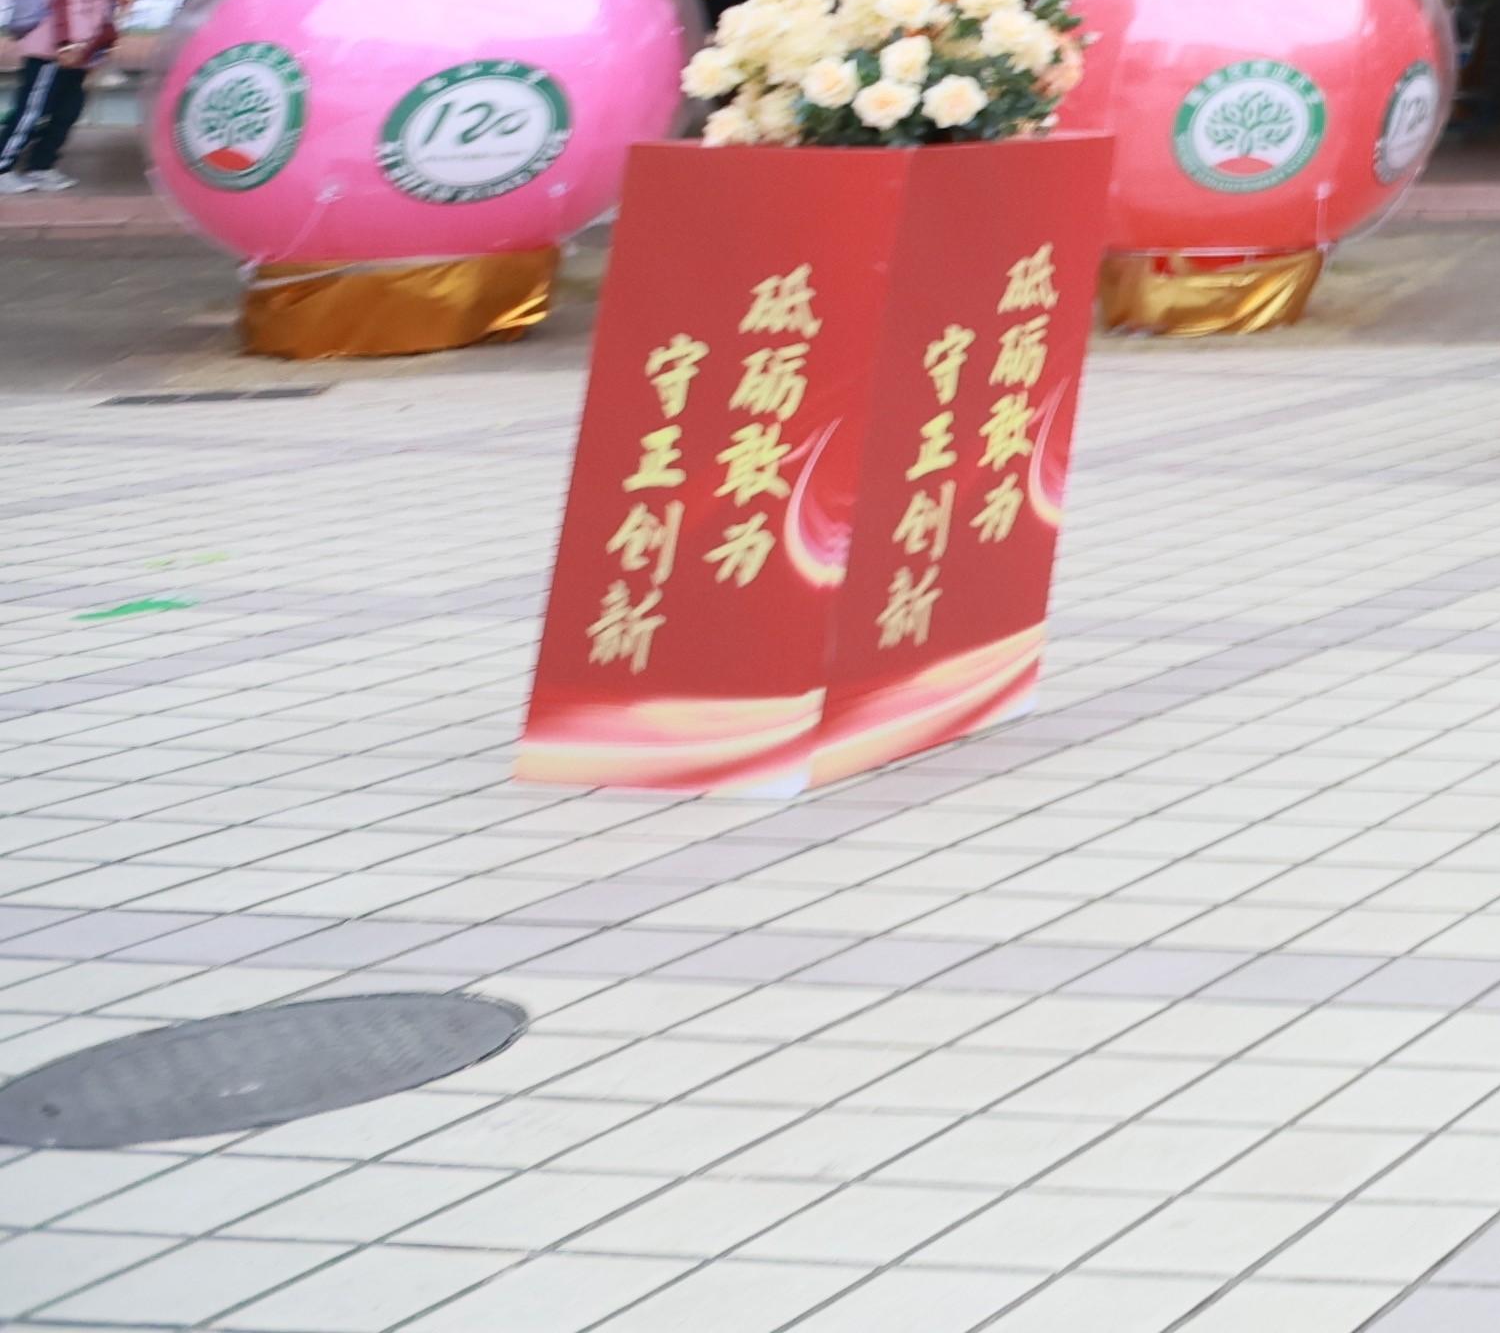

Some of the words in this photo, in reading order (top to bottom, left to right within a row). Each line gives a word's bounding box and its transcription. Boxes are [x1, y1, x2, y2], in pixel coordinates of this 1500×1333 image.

[586, 333, 710, 675] 守正创新
[704, 262, 823, 588] 砥砺敢为
[876, 323, 977, 650] 守正创新
[970, 242, 1060, 543] 砥砺敢为
